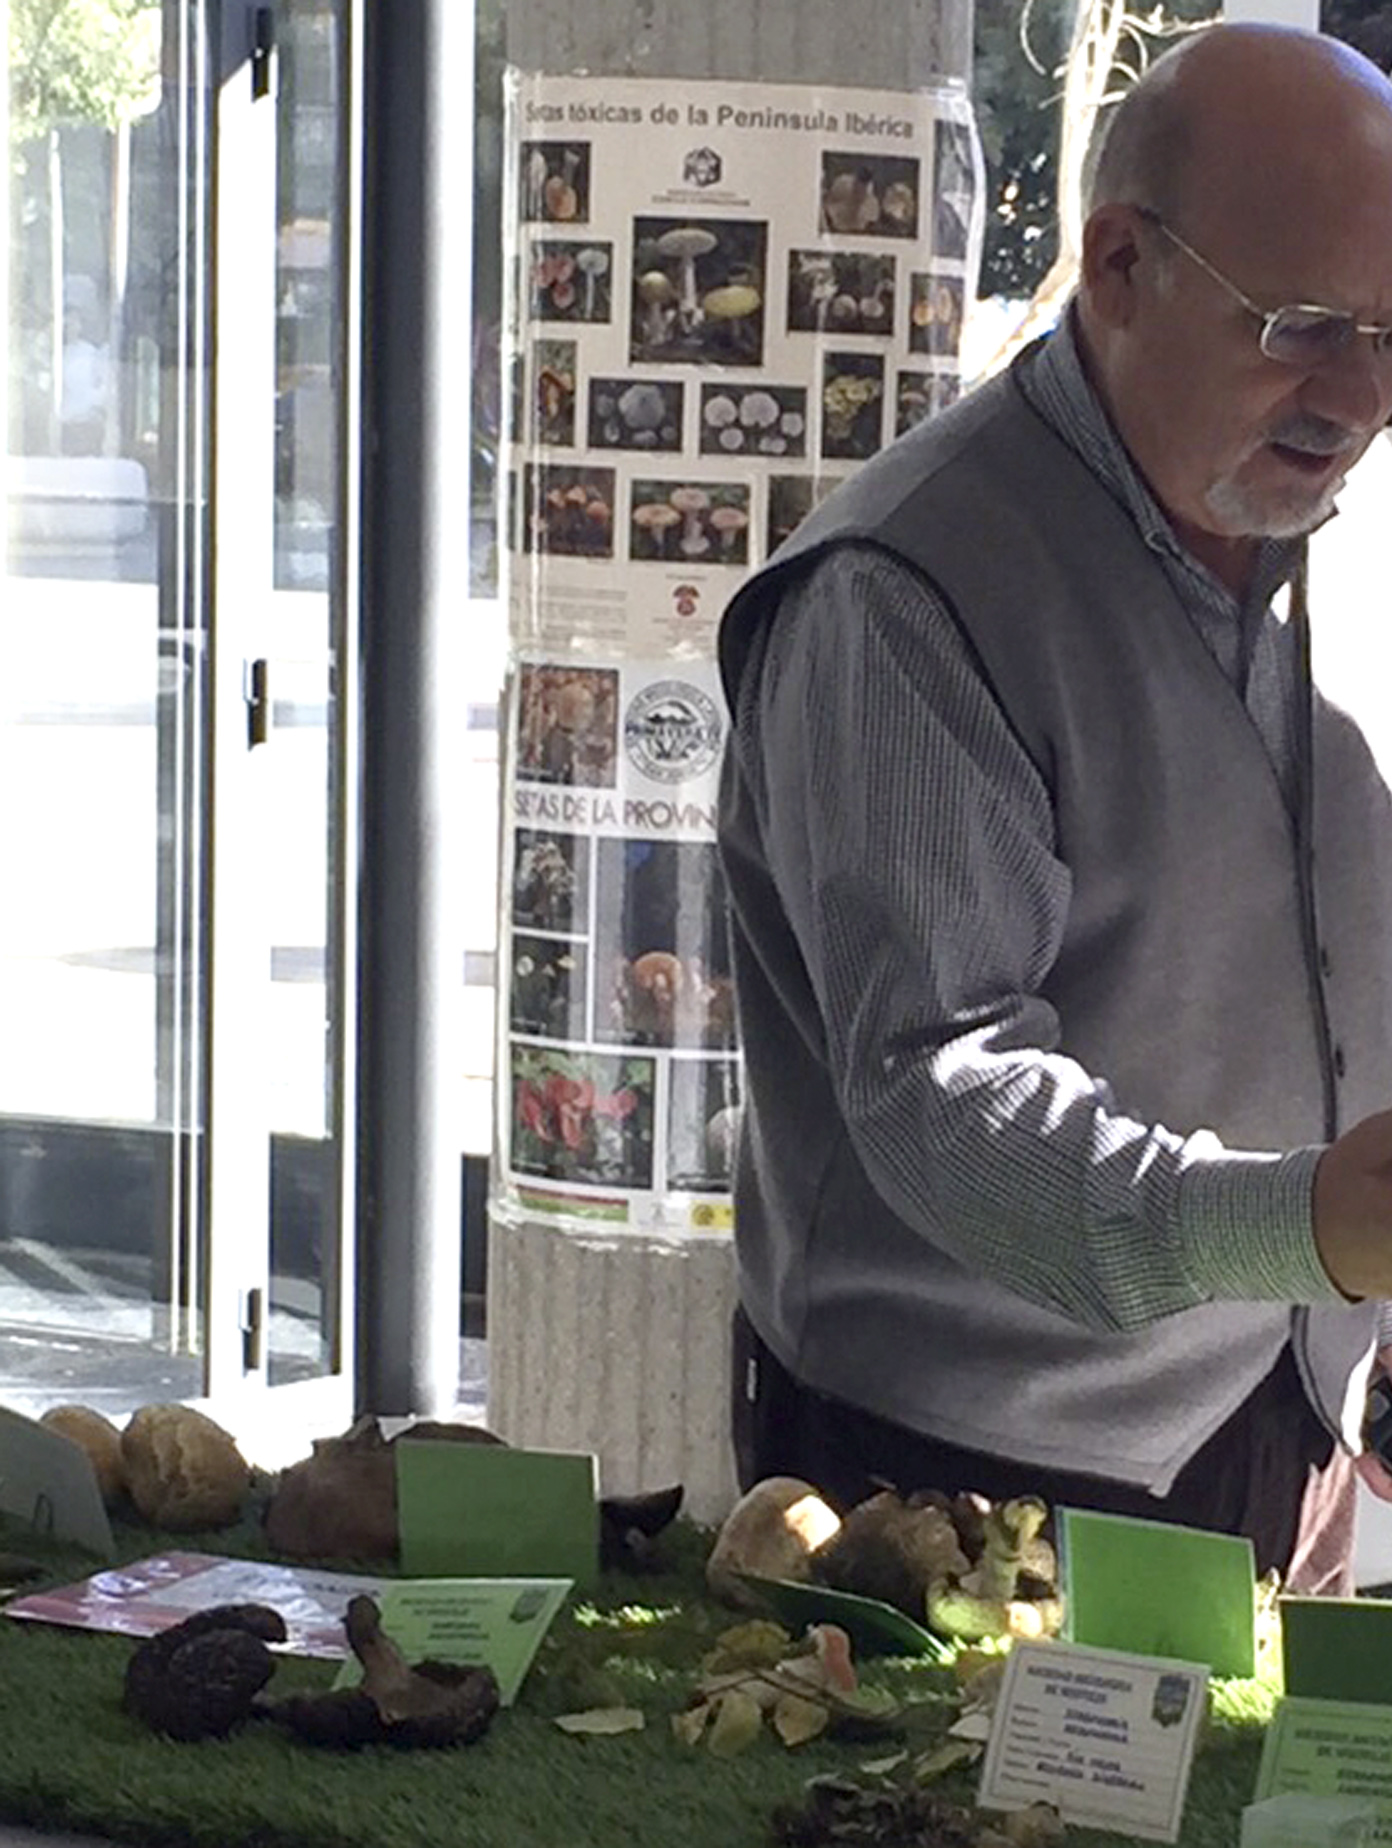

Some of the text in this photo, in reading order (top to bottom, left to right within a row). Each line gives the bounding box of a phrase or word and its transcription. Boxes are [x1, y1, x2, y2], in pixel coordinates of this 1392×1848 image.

[568, 101, 642, 124] tóxicas
[650, 103, 679, 125] de
[688, 104, 708, 126] la
[845, 112, 914, 139] Ibérica
[515, 790, 559, 822] SETAS
[563, 795, 588, 824] DE
[592, 797, 617, 825] LA
